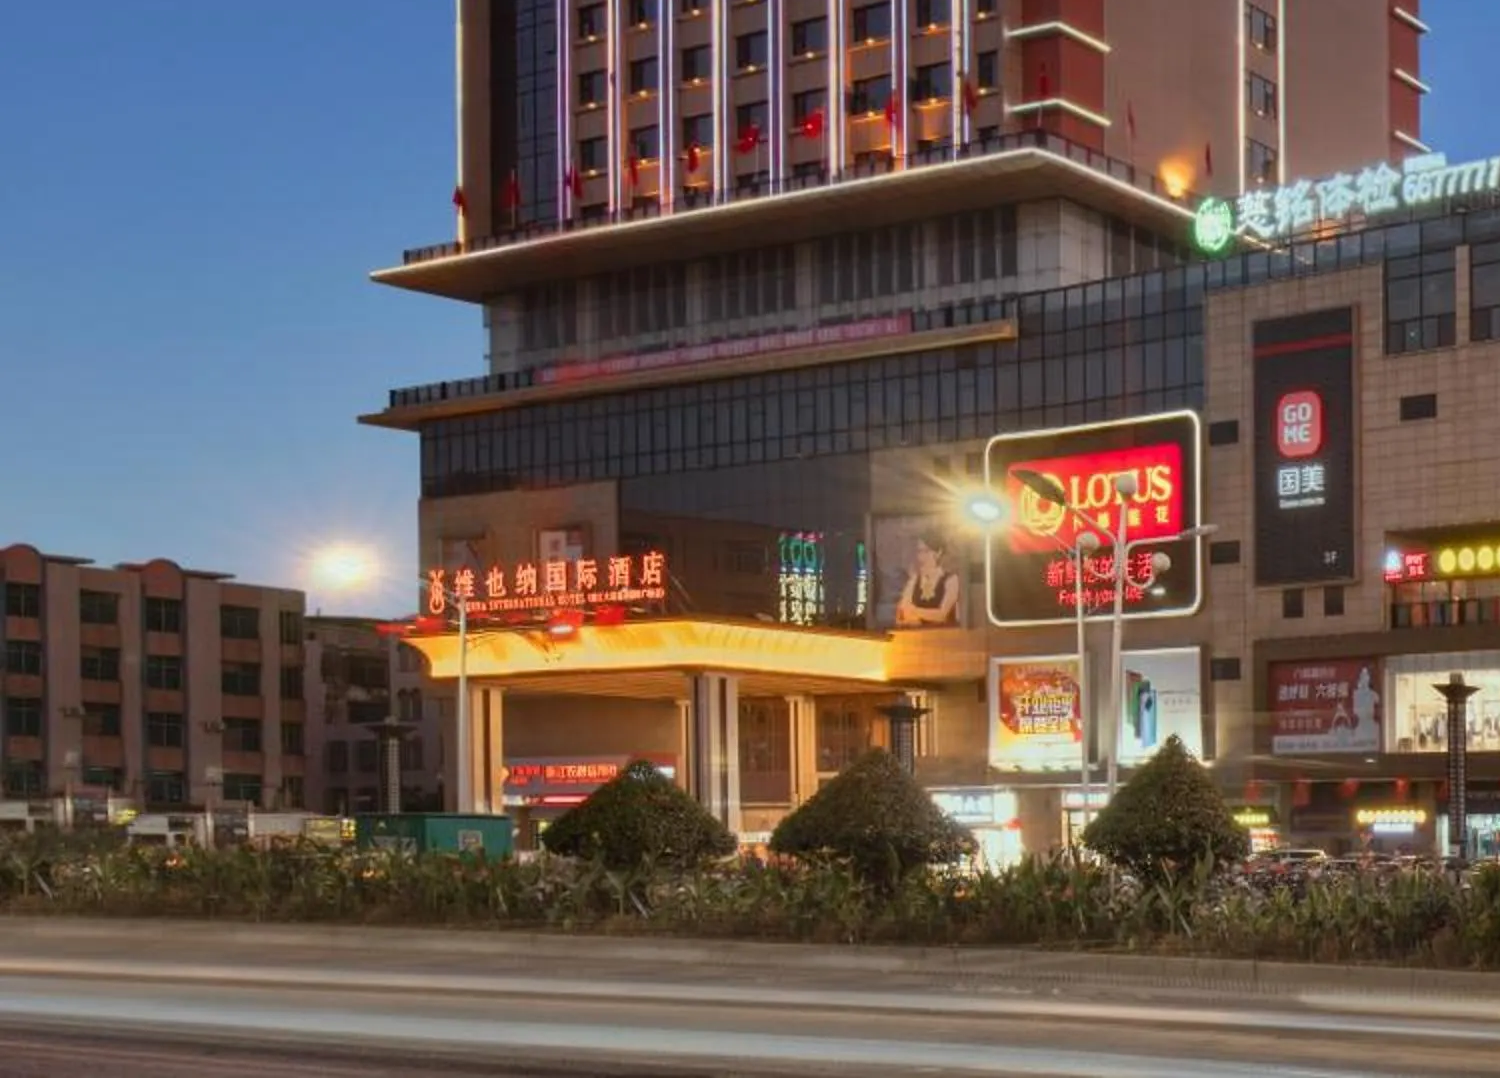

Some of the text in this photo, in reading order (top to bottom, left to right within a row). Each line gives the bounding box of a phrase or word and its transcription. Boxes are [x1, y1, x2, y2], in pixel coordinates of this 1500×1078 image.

[1277, 465, 1326, 497] 国美
[454, 550, 666, 598] 维也纳国际酒店
